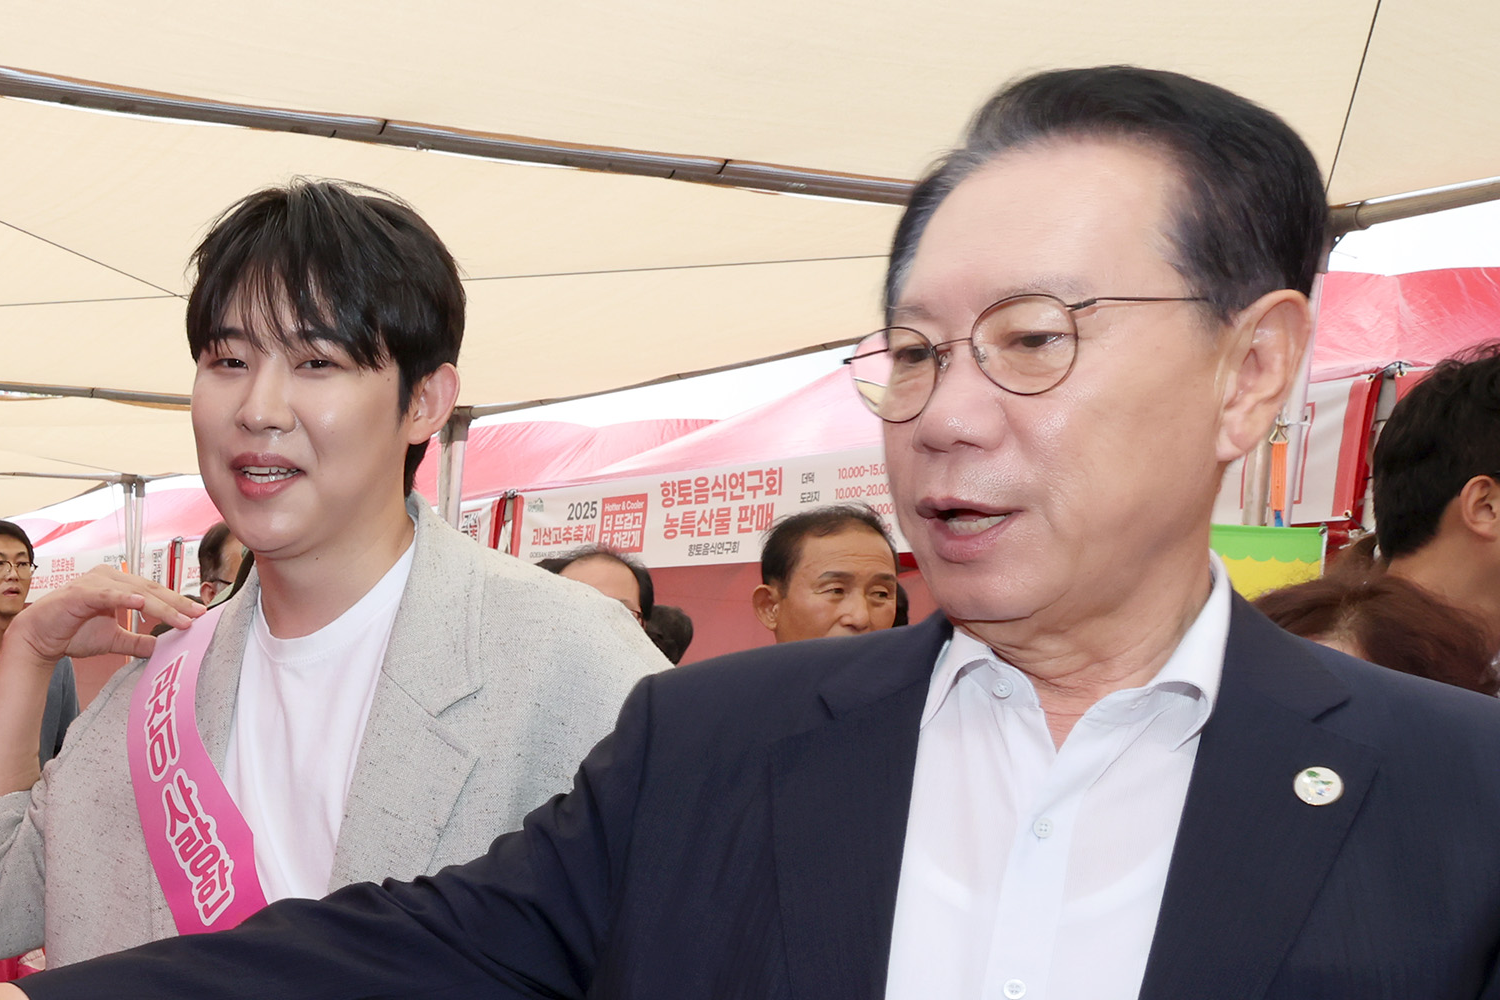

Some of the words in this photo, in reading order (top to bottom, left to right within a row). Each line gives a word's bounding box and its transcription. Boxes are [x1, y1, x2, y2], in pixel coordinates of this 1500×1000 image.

[660, 466, 782, 508] 향토음식연구회
[567, 501, 597, 521] 2025
[604, 502, 621, 512] Hotter
[626, 500, 644, 510] Cooler
[603, 515, 612, 530] 더
[614, 512, 642, 530] 뜨겁고
[663, 507, 732, 540] 농특산물
[737, 502, 774, 533] 판매
[531, 523, 596, 546] 괴산고추축제
[612, 530, 641, 548] 차갑게
[688, 541, 740, 557] 향토음식연구회
[147, 654, 185, 777] 괴산이
[165, 773, 231, 920] 사랑한
